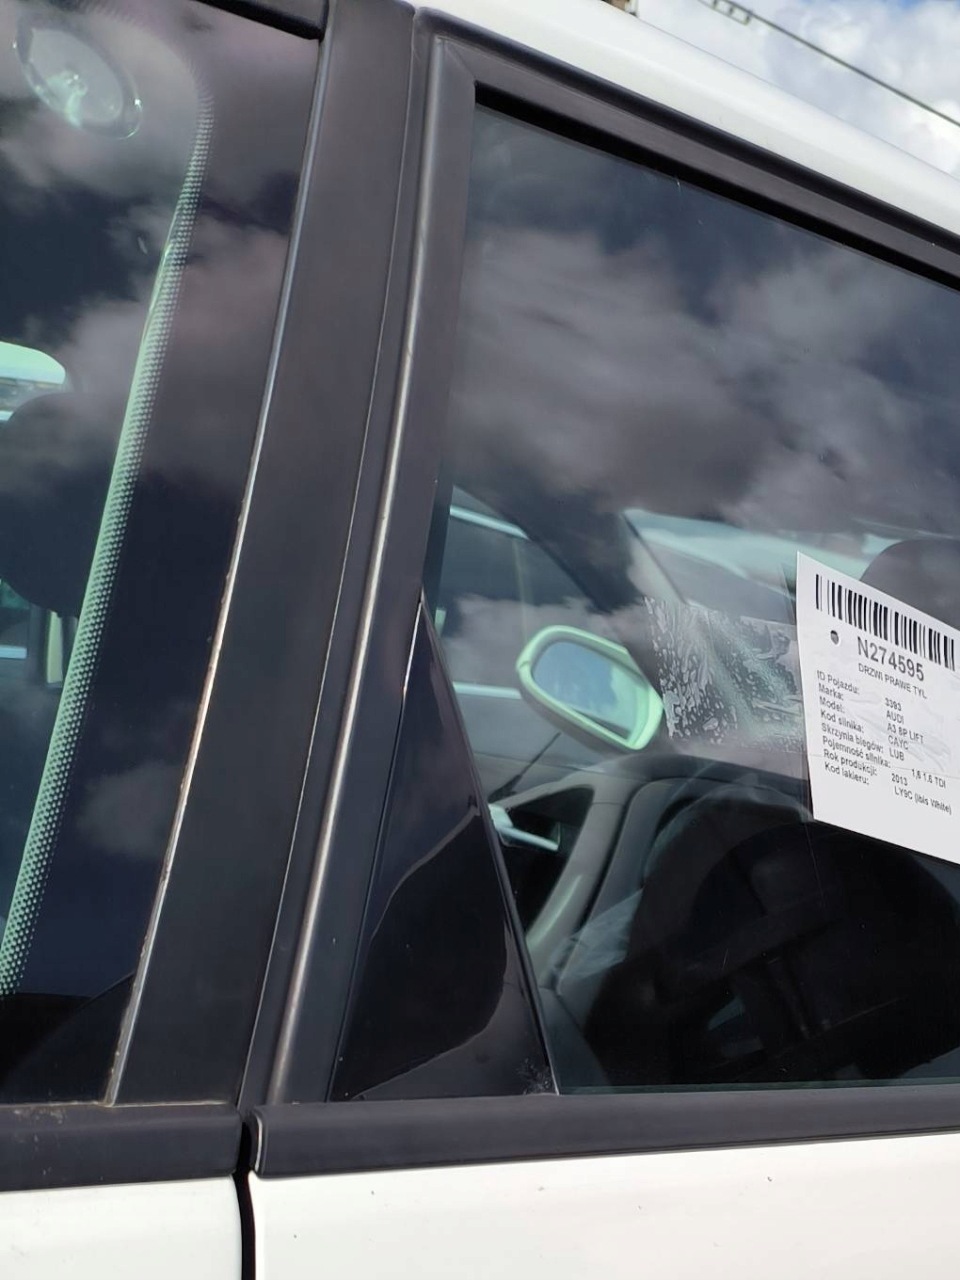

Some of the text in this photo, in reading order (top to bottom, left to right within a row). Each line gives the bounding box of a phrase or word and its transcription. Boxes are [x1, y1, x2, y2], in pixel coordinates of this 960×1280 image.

[857, 636, 924, 681] N274595
[817, 670, 825, 681] ID
[858, 663, 883, 681] DRZWI
[885, 674, 911, 692] PRAWE
[819, 683, 844, 700] Marka:
[820, 696, 845, 713] Model:
[821, 709, 836, 722] Kod
[886, 710, 904, 724] AUDI
[888, 723, 896, 733] A3
[888, 735, 908, 750] CAYC
[824, 749, 838, 762] Rok
[889, 748, 904, 761] LUB
[825, 762, 840, 775] Kod
[892, 773, 908, 786] 2013
[934, 777, 945, 788] TDI
